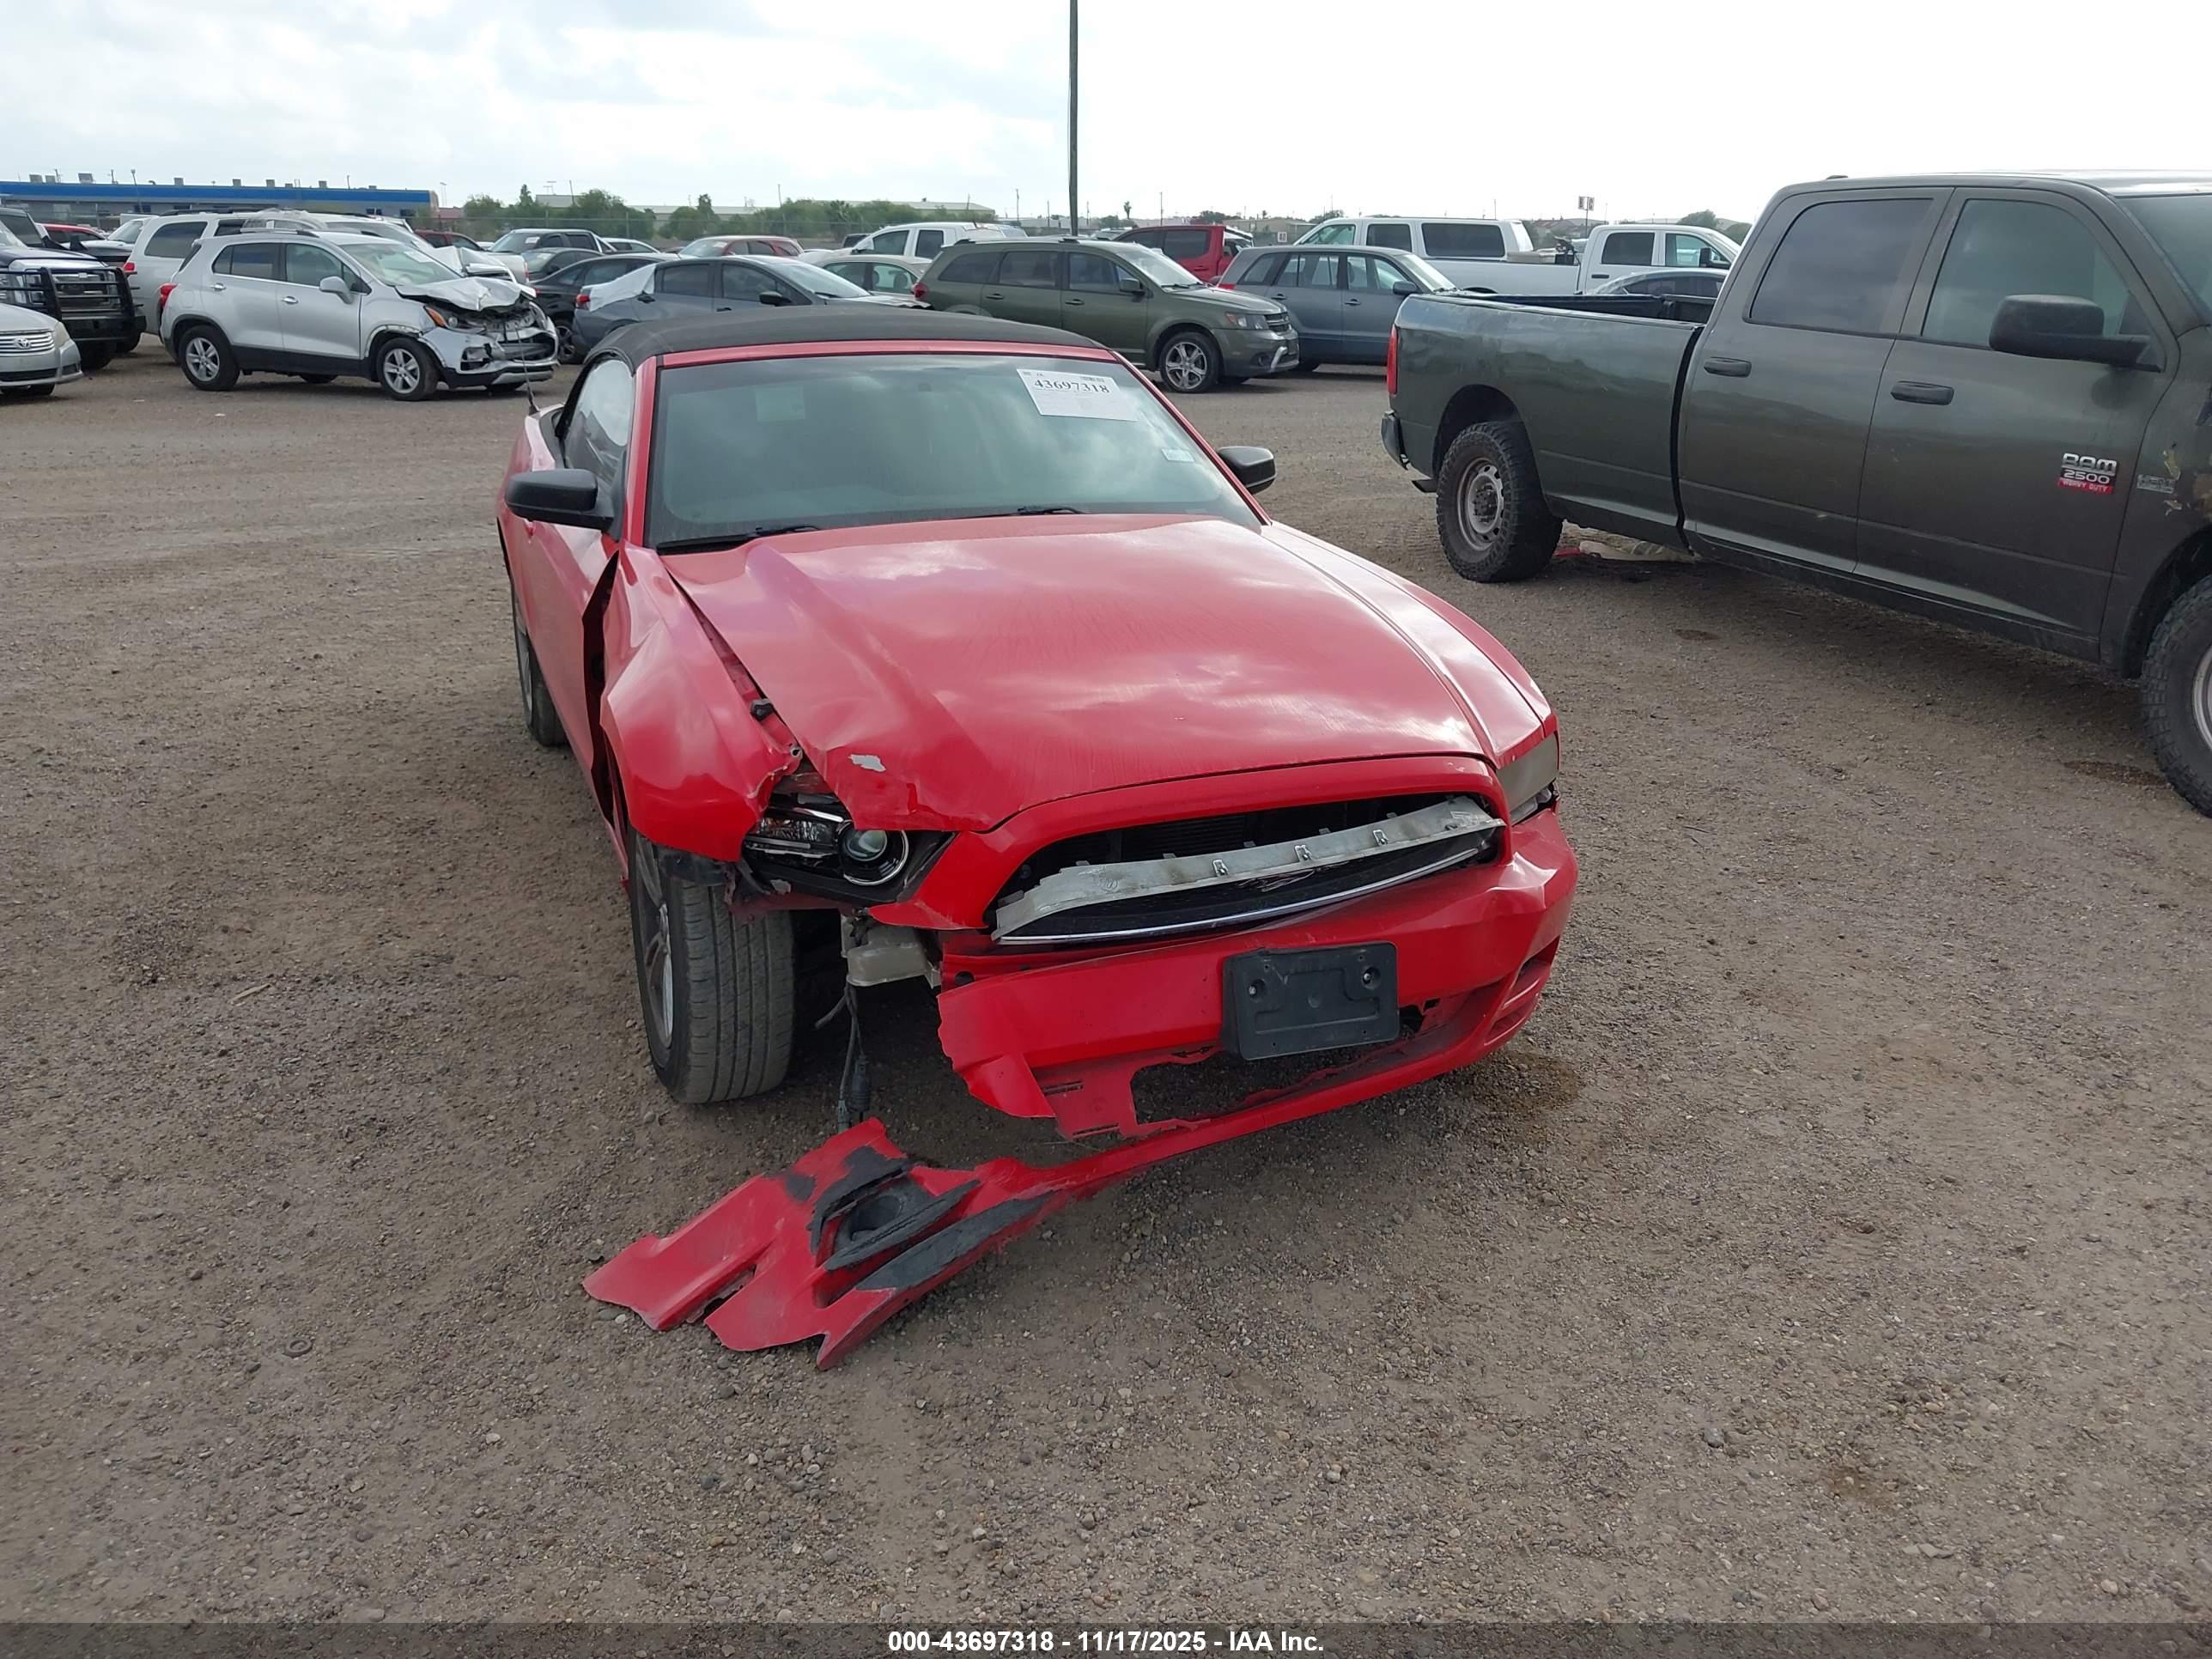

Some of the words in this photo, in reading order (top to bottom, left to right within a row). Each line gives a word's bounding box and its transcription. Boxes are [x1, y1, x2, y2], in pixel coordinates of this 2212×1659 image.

[1034, 379, 1110, 393] 43697318
[2062, 453, 2117, 473] RAM
[2063, 469, 2110, 484] 2500
